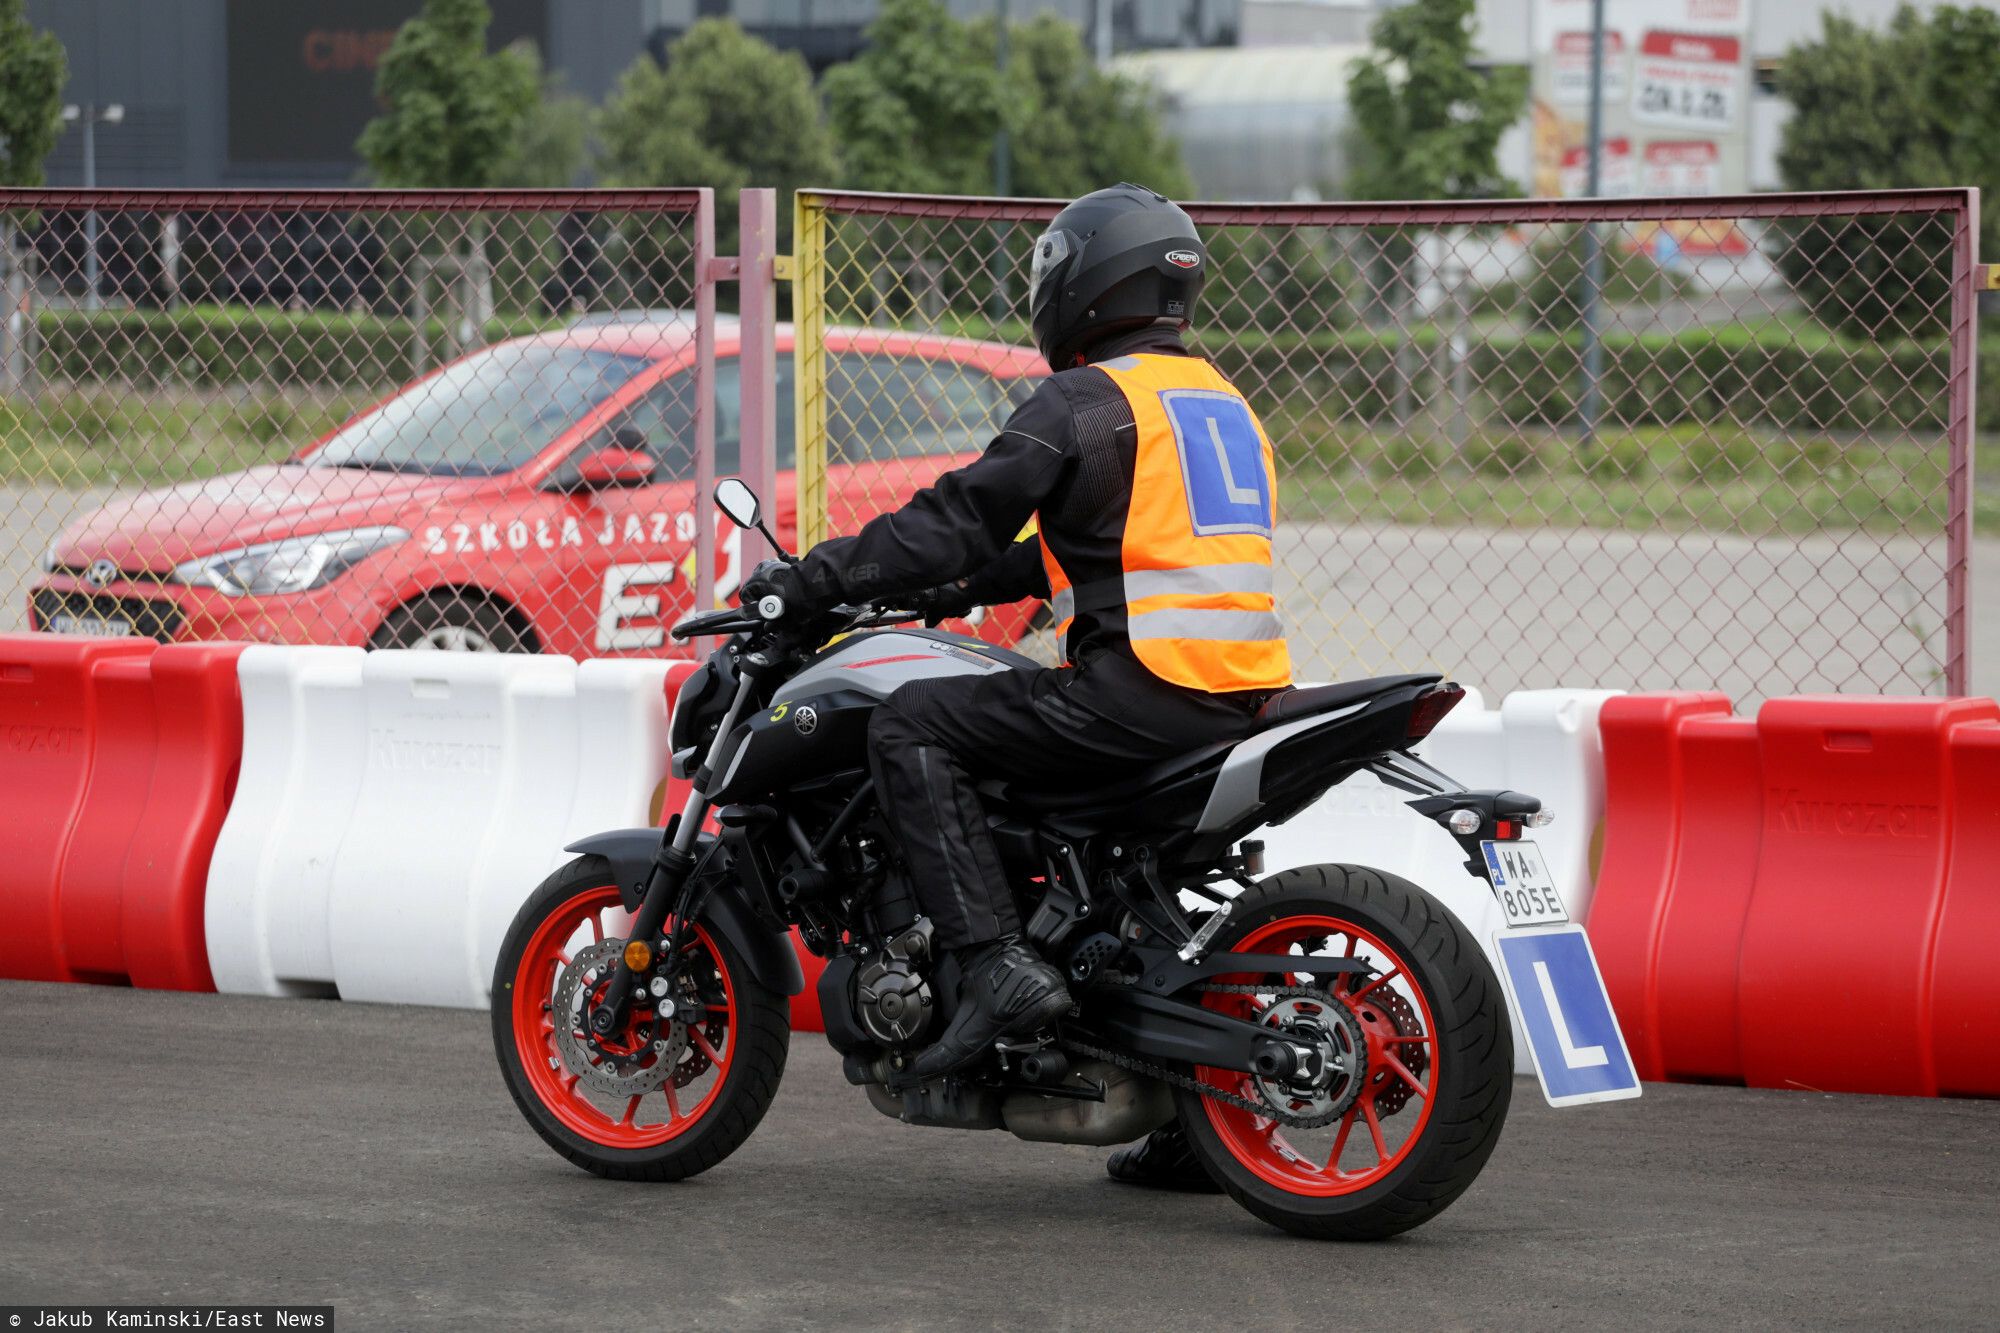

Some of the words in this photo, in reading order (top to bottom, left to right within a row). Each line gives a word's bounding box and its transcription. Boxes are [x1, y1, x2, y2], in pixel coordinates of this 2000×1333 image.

[1205, 416, 1261, 506] L
[424, 515, 583, 554] SZKOŁA
[597, 511, 722, 546] JAZD
[770, 700, 793, 722] 5
[1767, 788, 1938, 838] Kwazar
[1503, 885, 1562, 918] 805E
[1531, 960, 1610, 1070] L
